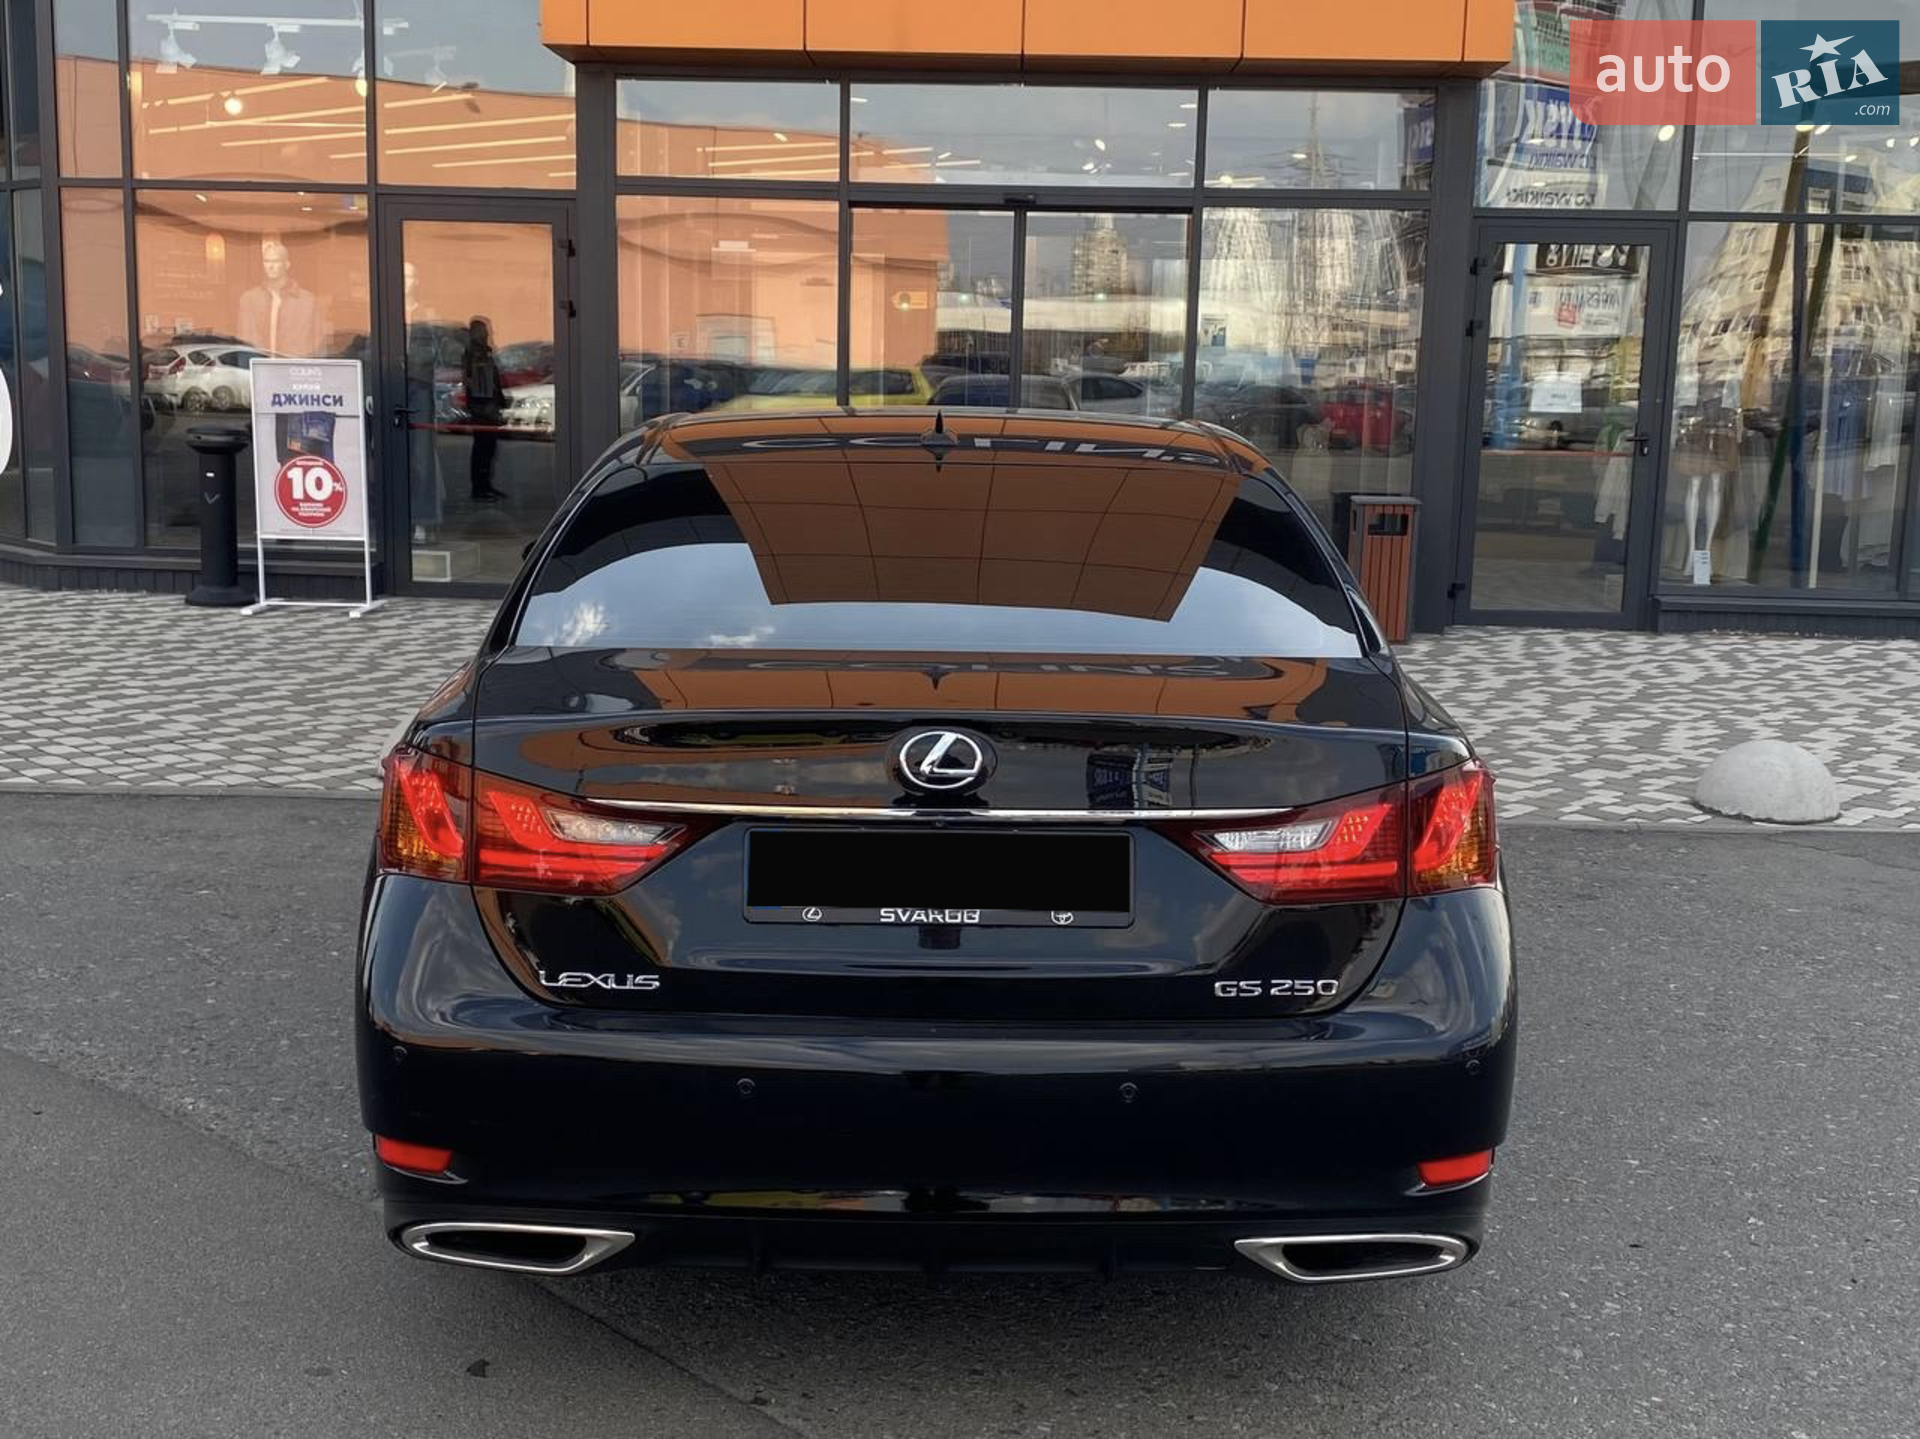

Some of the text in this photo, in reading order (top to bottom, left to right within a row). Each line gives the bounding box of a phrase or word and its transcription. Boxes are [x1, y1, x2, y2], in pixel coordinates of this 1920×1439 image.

[271, 393, 343, 408] ДЖИНСИ
[538, 970, 660, 990] LEXUS
[1213, 979, 1339, 997] GS 250
